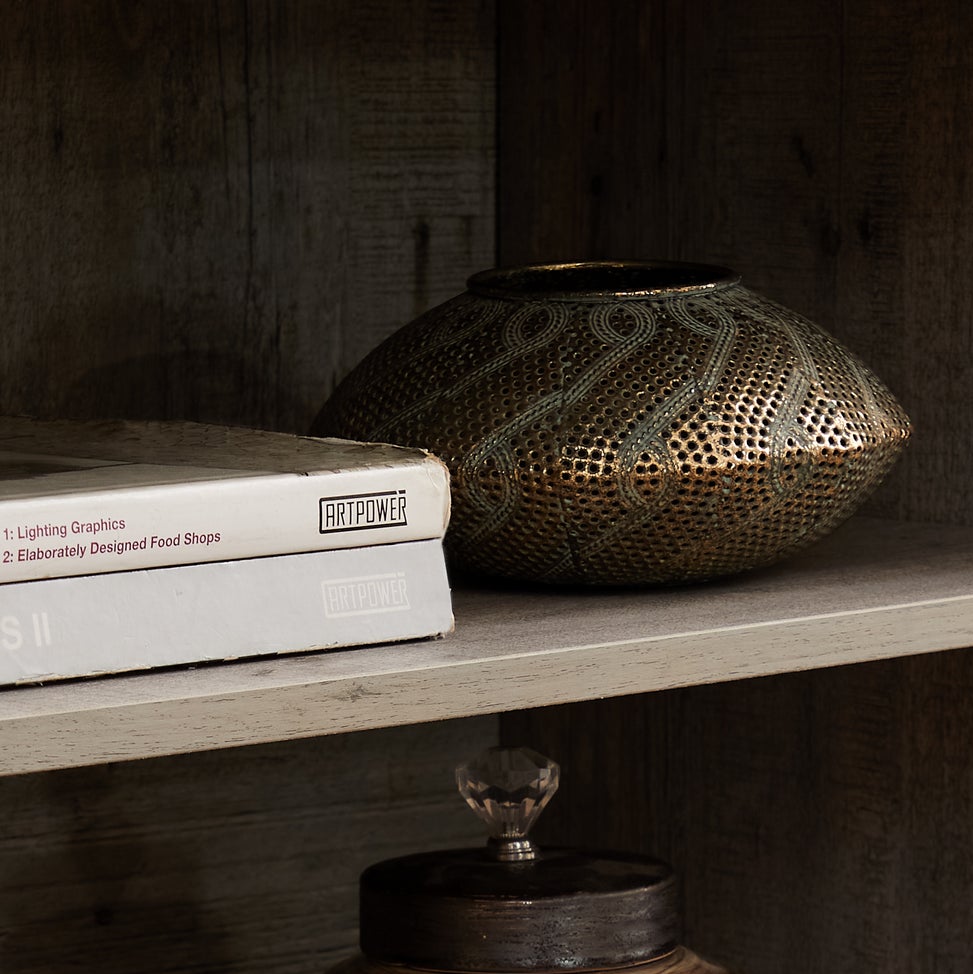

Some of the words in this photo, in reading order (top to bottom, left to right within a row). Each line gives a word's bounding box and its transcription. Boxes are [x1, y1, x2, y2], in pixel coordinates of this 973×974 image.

[326, 496, 408, 528] ARTPOWER
[3, 528, 14, 541] 1:
[17, 524, 68, 541] Lighting
[71, 518, 126, 535] Graphics
[2, 550, 14, 563] 2:
[17, 545, 87, 562] Elaborately
[90, 537, 147, 556] Designed
[150, 533, 181, 549] Food
[183, 531, 221, 546] Shops
[327, 578, 411, 612] ARTPOWER
